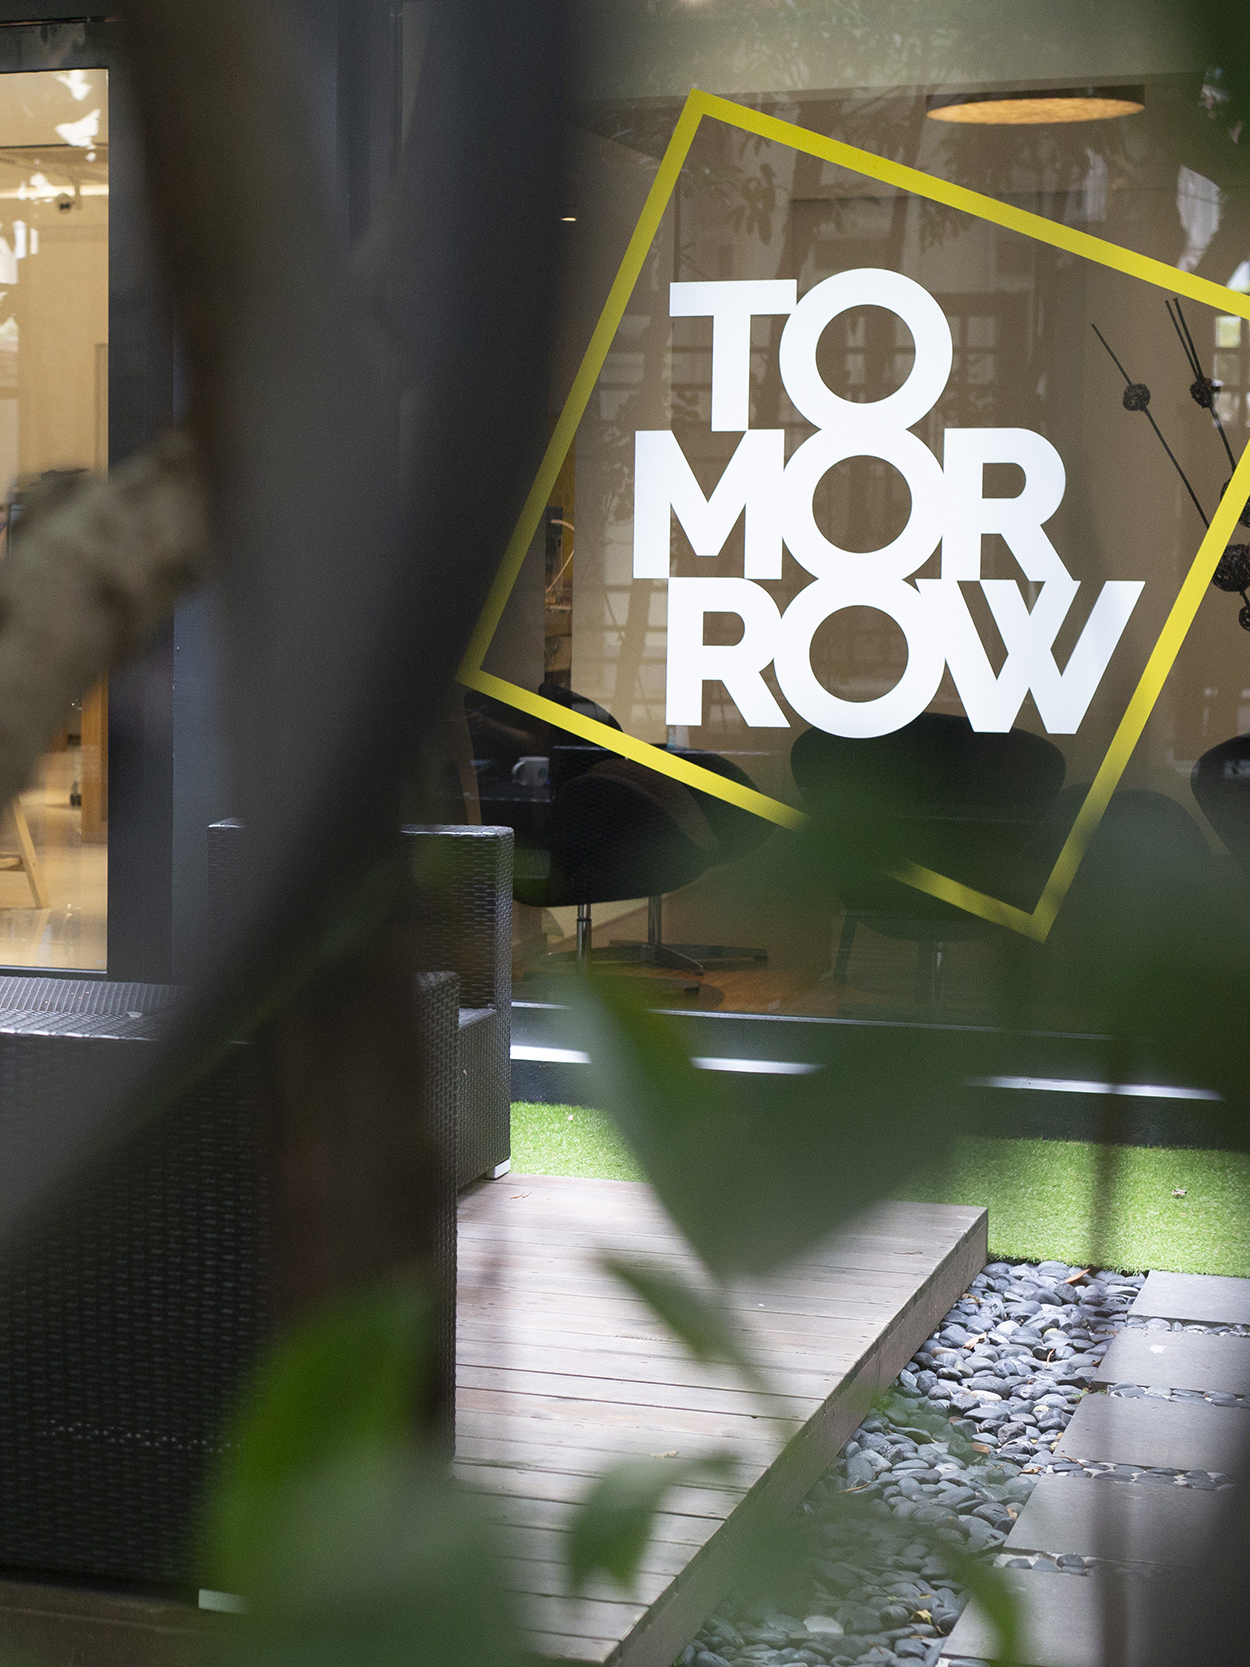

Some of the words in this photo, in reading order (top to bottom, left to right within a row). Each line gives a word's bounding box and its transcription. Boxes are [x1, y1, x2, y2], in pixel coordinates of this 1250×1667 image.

[670, 268, 953, 438] TO
[633, 424, 1074, 583] MOR
[665, 575, 1146, 738] ROW
